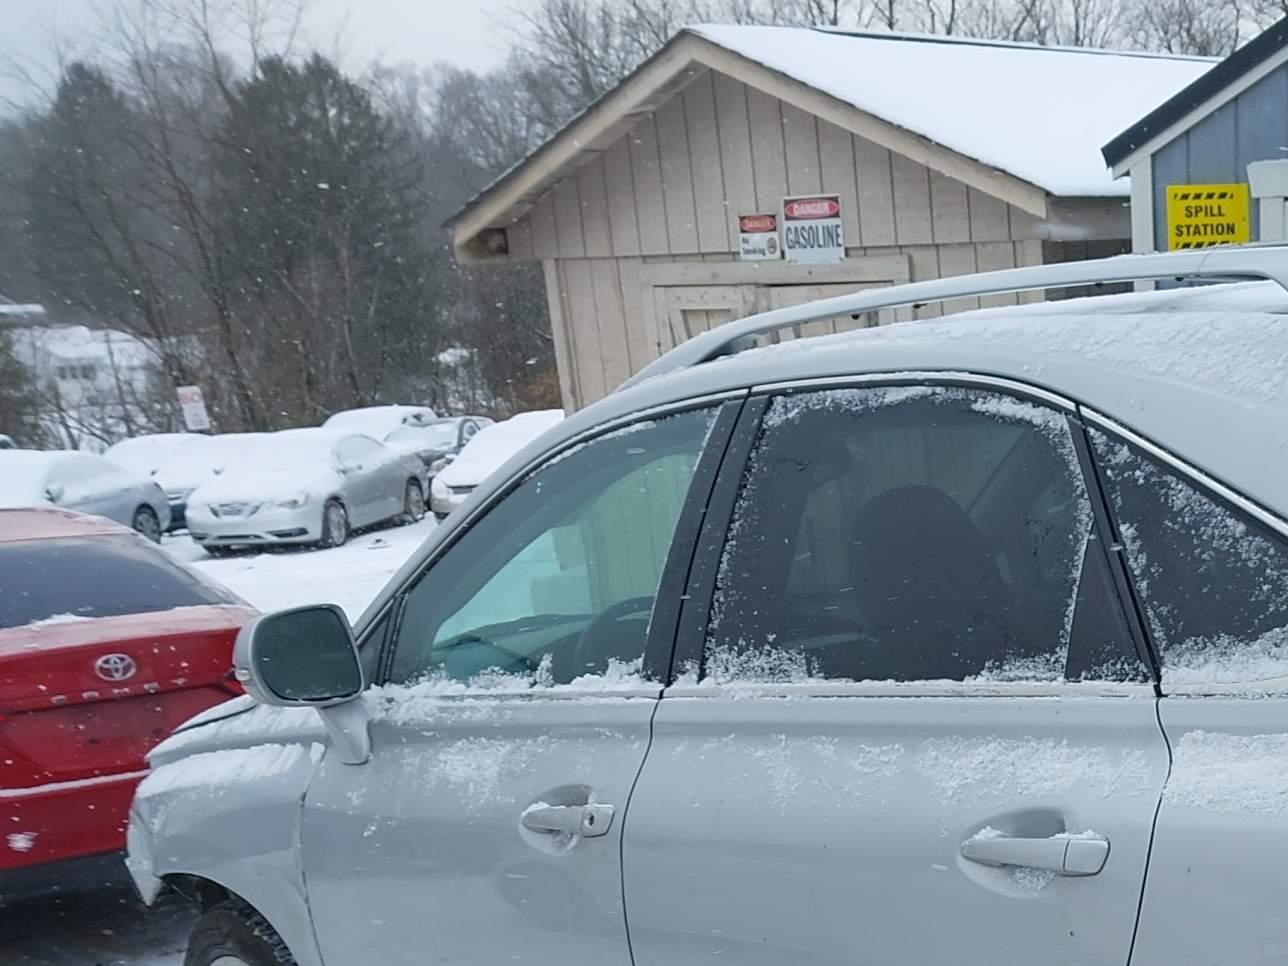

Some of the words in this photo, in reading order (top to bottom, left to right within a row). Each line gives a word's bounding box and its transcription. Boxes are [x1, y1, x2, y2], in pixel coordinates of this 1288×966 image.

[793, 202, 829, 216] DANGER
[1184, 204, 1226, 218] SPILL
[785, 223, 842, 250] GASOLINE
[1175, 222, 1236, 237] STATION
